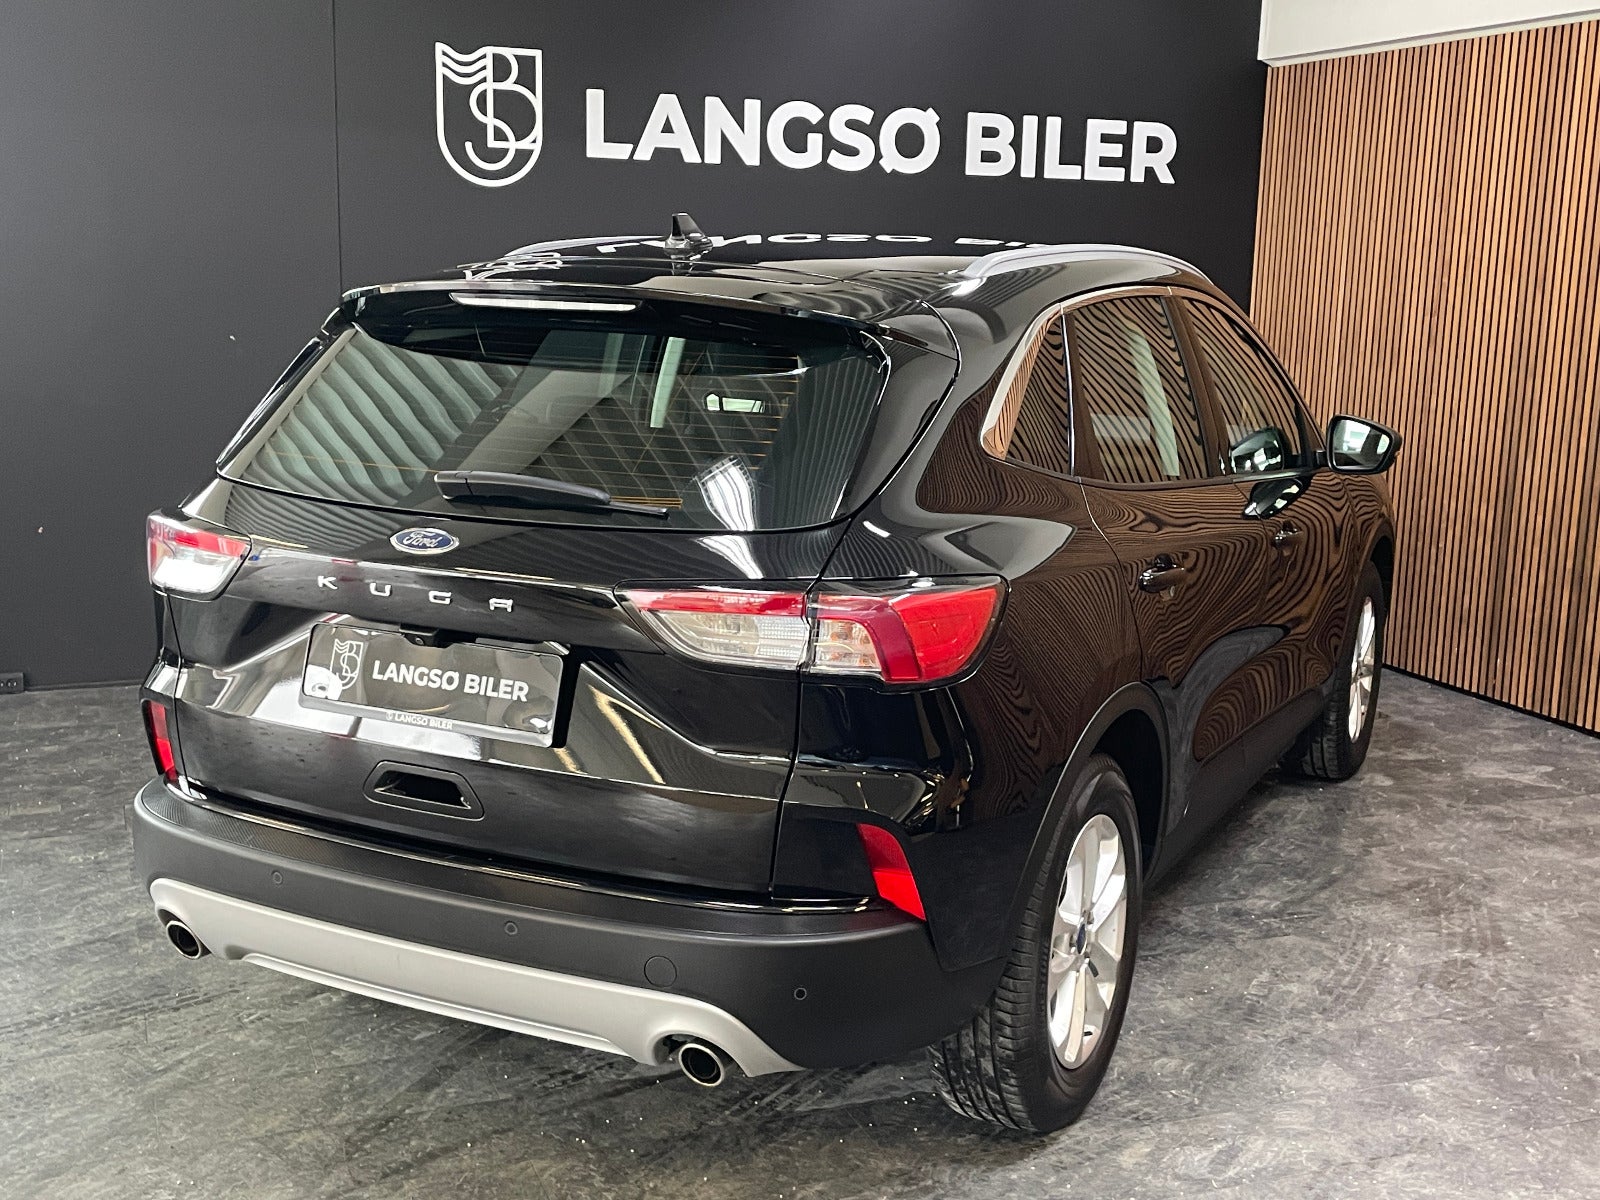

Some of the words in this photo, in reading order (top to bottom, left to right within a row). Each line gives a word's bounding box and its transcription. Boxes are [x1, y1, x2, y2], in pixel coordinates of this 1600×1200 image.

[585, 88, 941, 175] LANGSØ
[964, 111, 1177, 185] BILER
[402, 529, 442, 549] Ford
[317, 575, 514, 612] KUGA
[371, 659, 460, 692] LANGSØ
[463, 673, 529, 702] BILER
[429, 718, 453, 730] BILER
